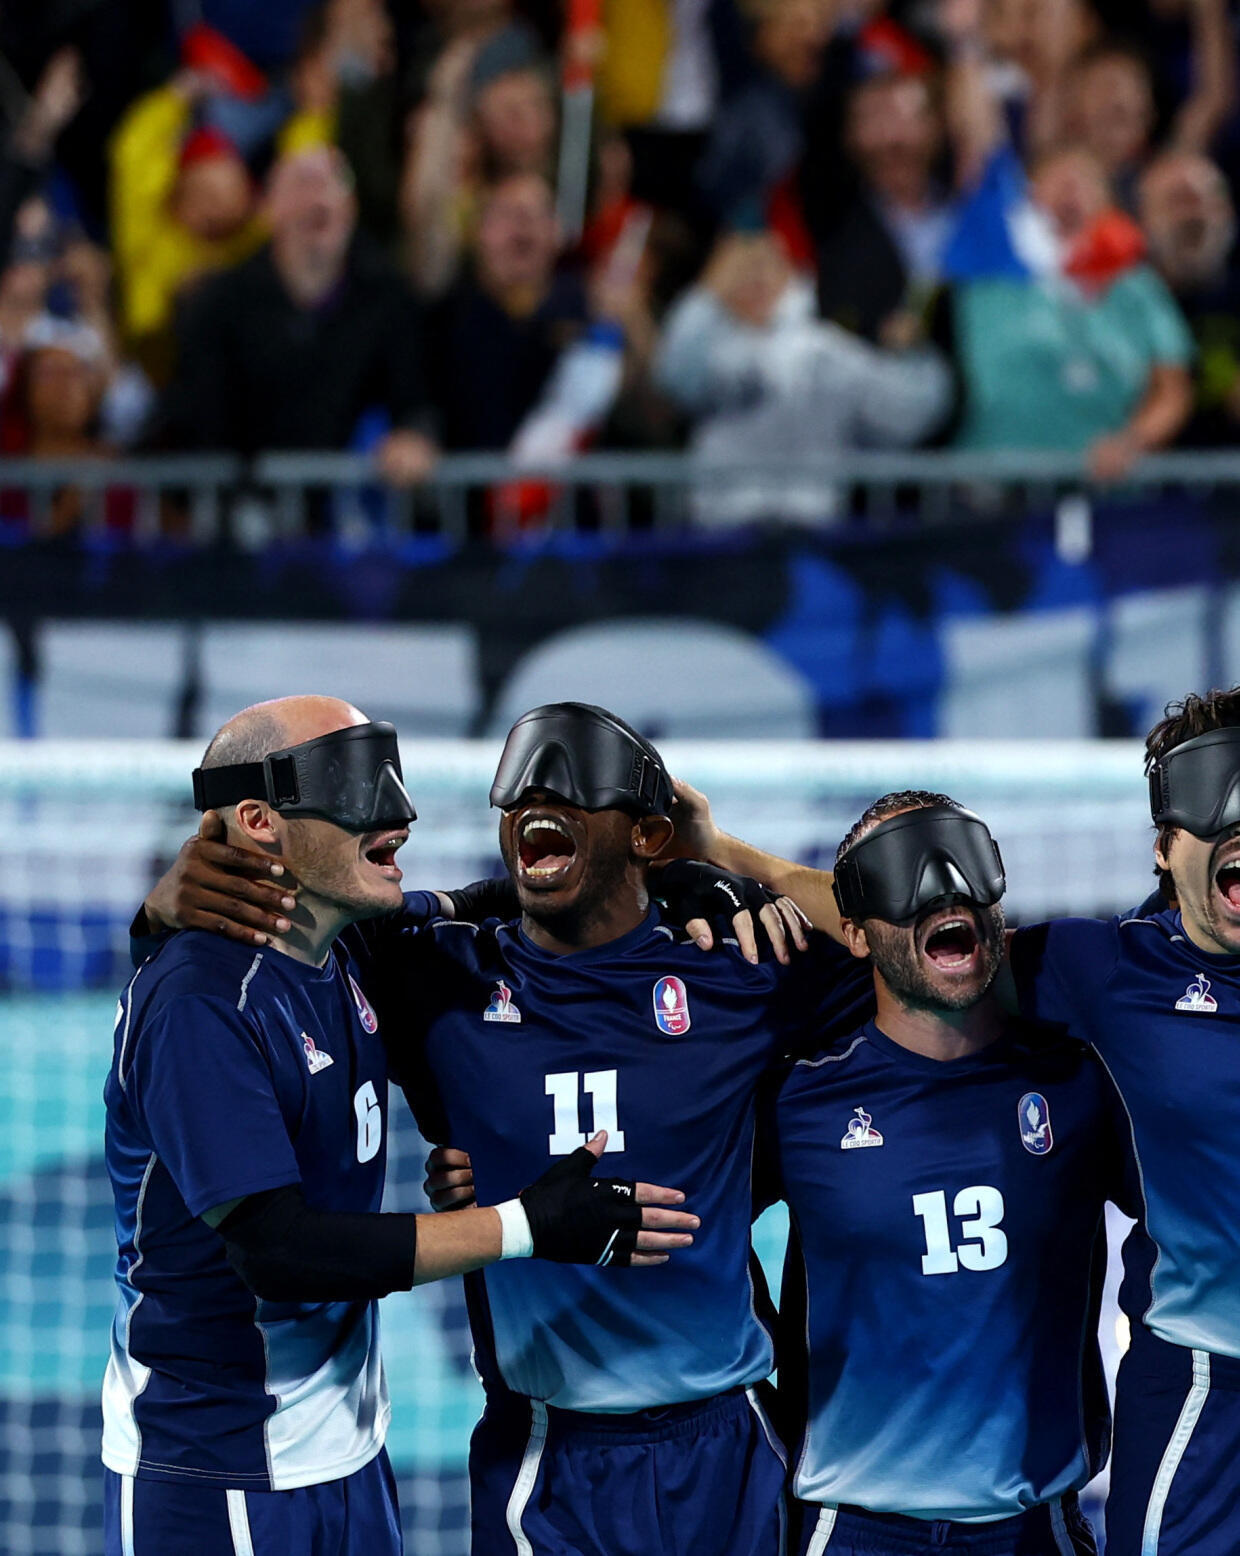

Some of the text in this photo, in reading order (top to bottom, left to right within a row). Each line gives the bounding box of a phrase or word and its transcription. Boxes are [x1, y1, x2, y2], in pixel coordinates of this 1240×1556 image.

[353, 1080, 382, 1164] 6
[545, 1069, 625, 1155] 11
[912, 1185, 1008, 1275] 13
